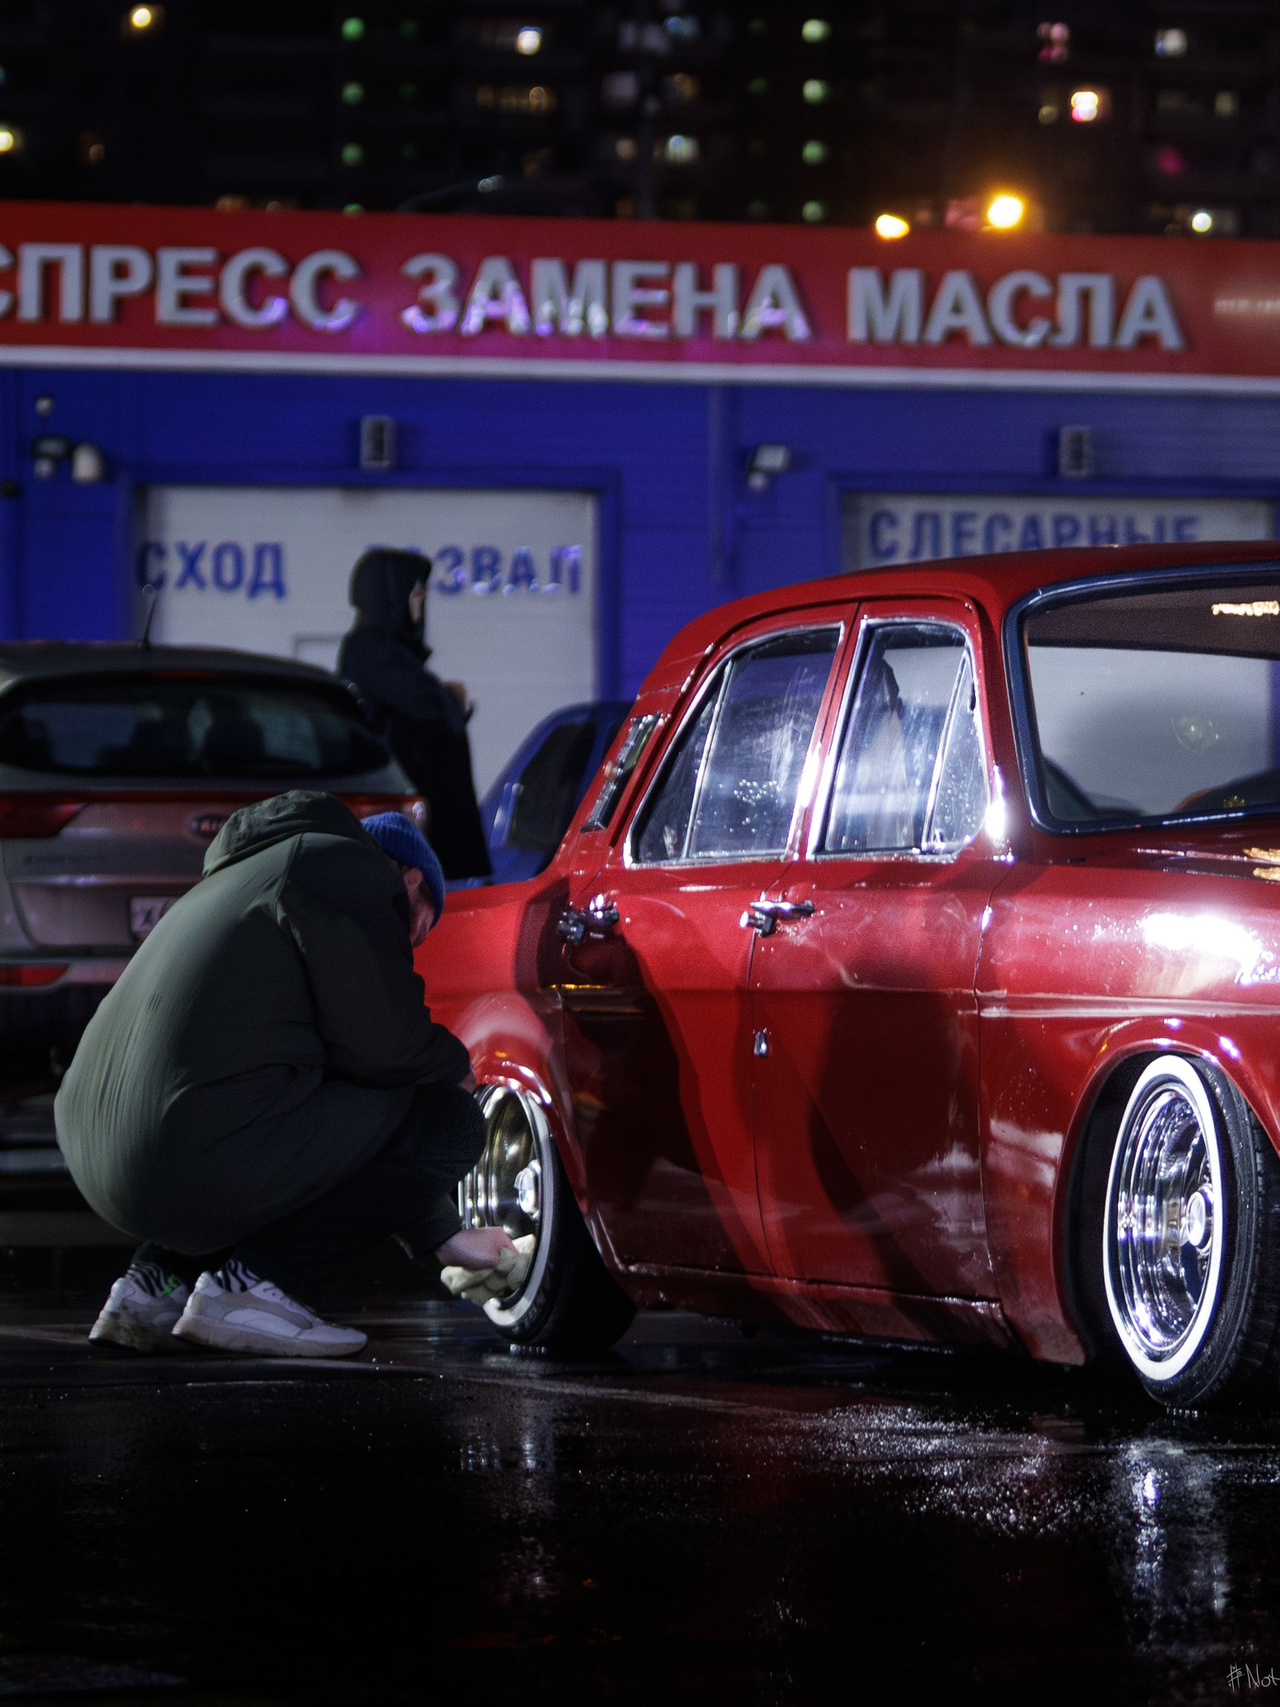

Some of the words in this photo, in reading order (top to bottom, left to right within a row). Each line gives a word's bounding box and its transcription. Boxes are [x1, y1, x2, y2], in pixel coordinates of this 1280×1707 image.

[0, 242, 360, 330] ПРЕСС
[401, 252, 812, 341] ЗАМЕНА
[847, 266, 1187, 349] МАСЛА
[136, 540, 288, 600] СХОД
